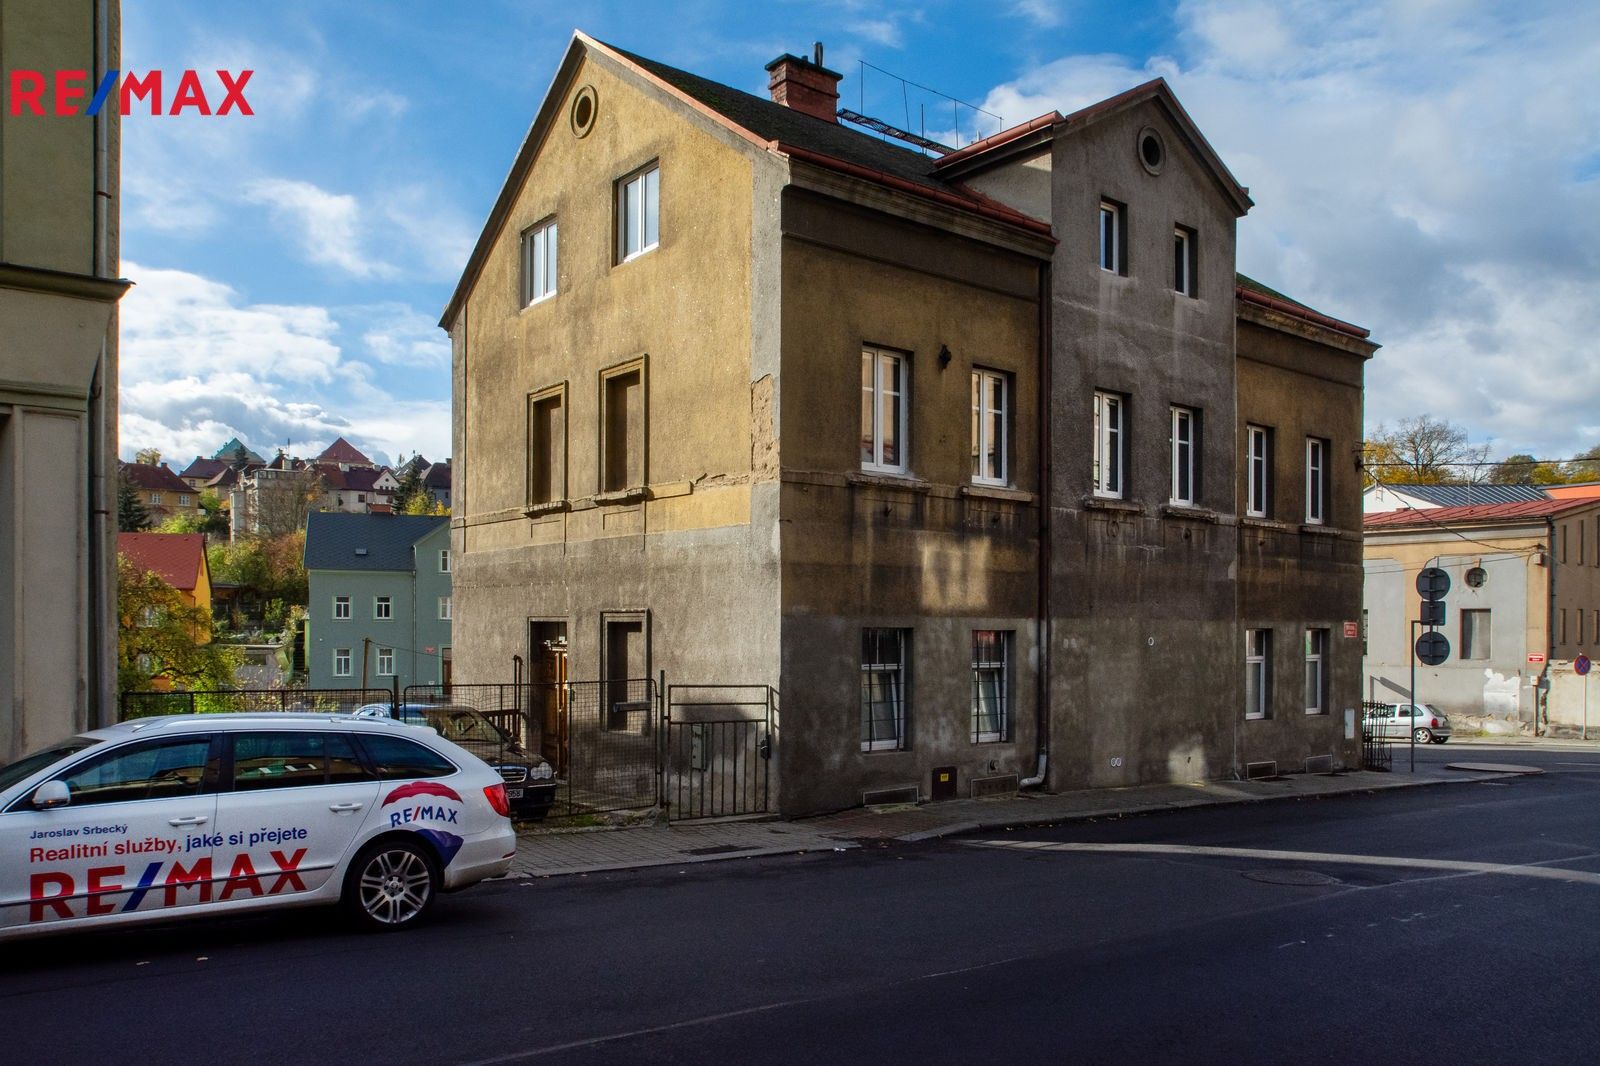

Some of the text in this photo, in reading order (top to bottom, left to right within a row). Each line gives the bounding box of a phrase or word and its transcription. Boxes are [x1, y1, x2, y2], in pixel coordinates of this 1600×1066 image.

[30, 823, 128, 839] Jaroslav Srbecký
[390, 806, 458, 828] RE/MAX
[30, 827, 308, 863] Realitní služby, jaké si přejete
[29, 848, 308, 922] RE/MAX
